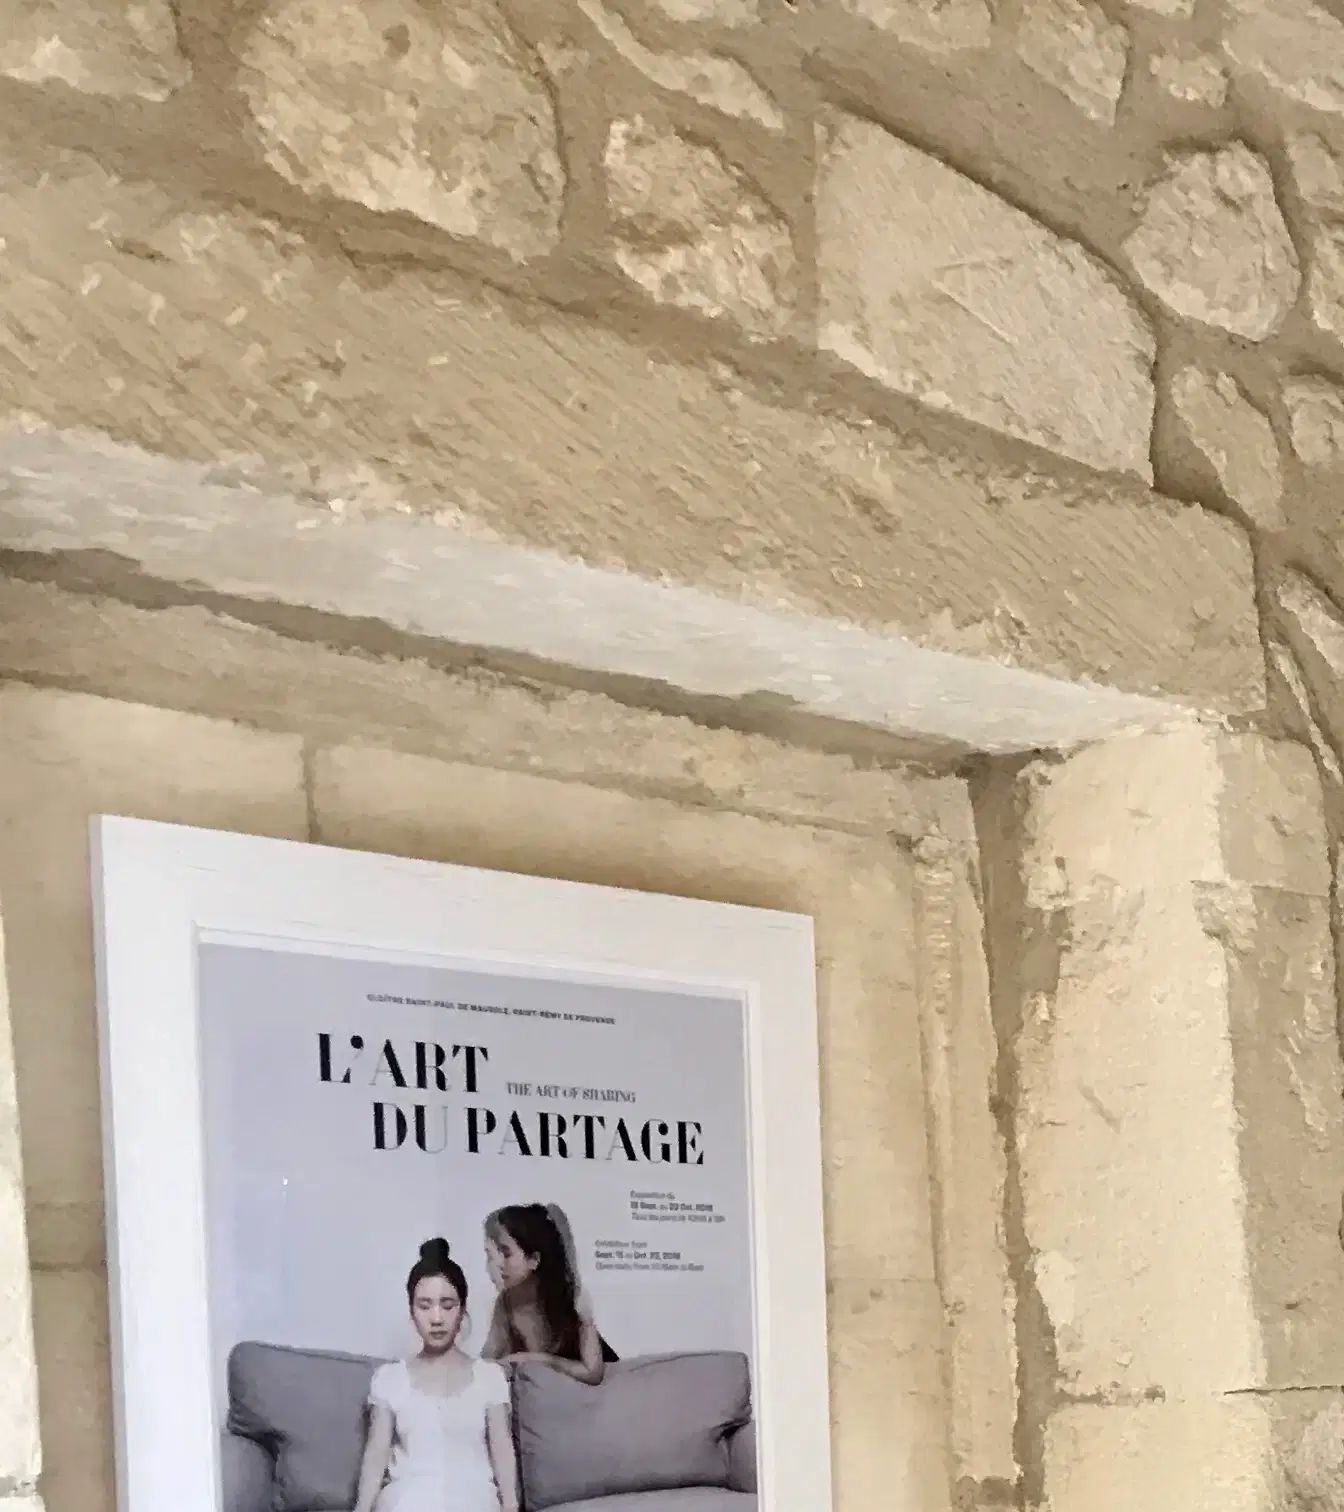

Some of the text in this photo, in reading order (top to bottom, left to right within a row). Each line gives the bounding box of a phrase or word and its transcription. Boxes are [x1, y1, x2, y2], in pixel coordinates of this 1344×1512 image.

[506, 1081, 637, 1104] THE ART OF SHARING
[370, 1101, 705, 1166] DU PARTAGE
